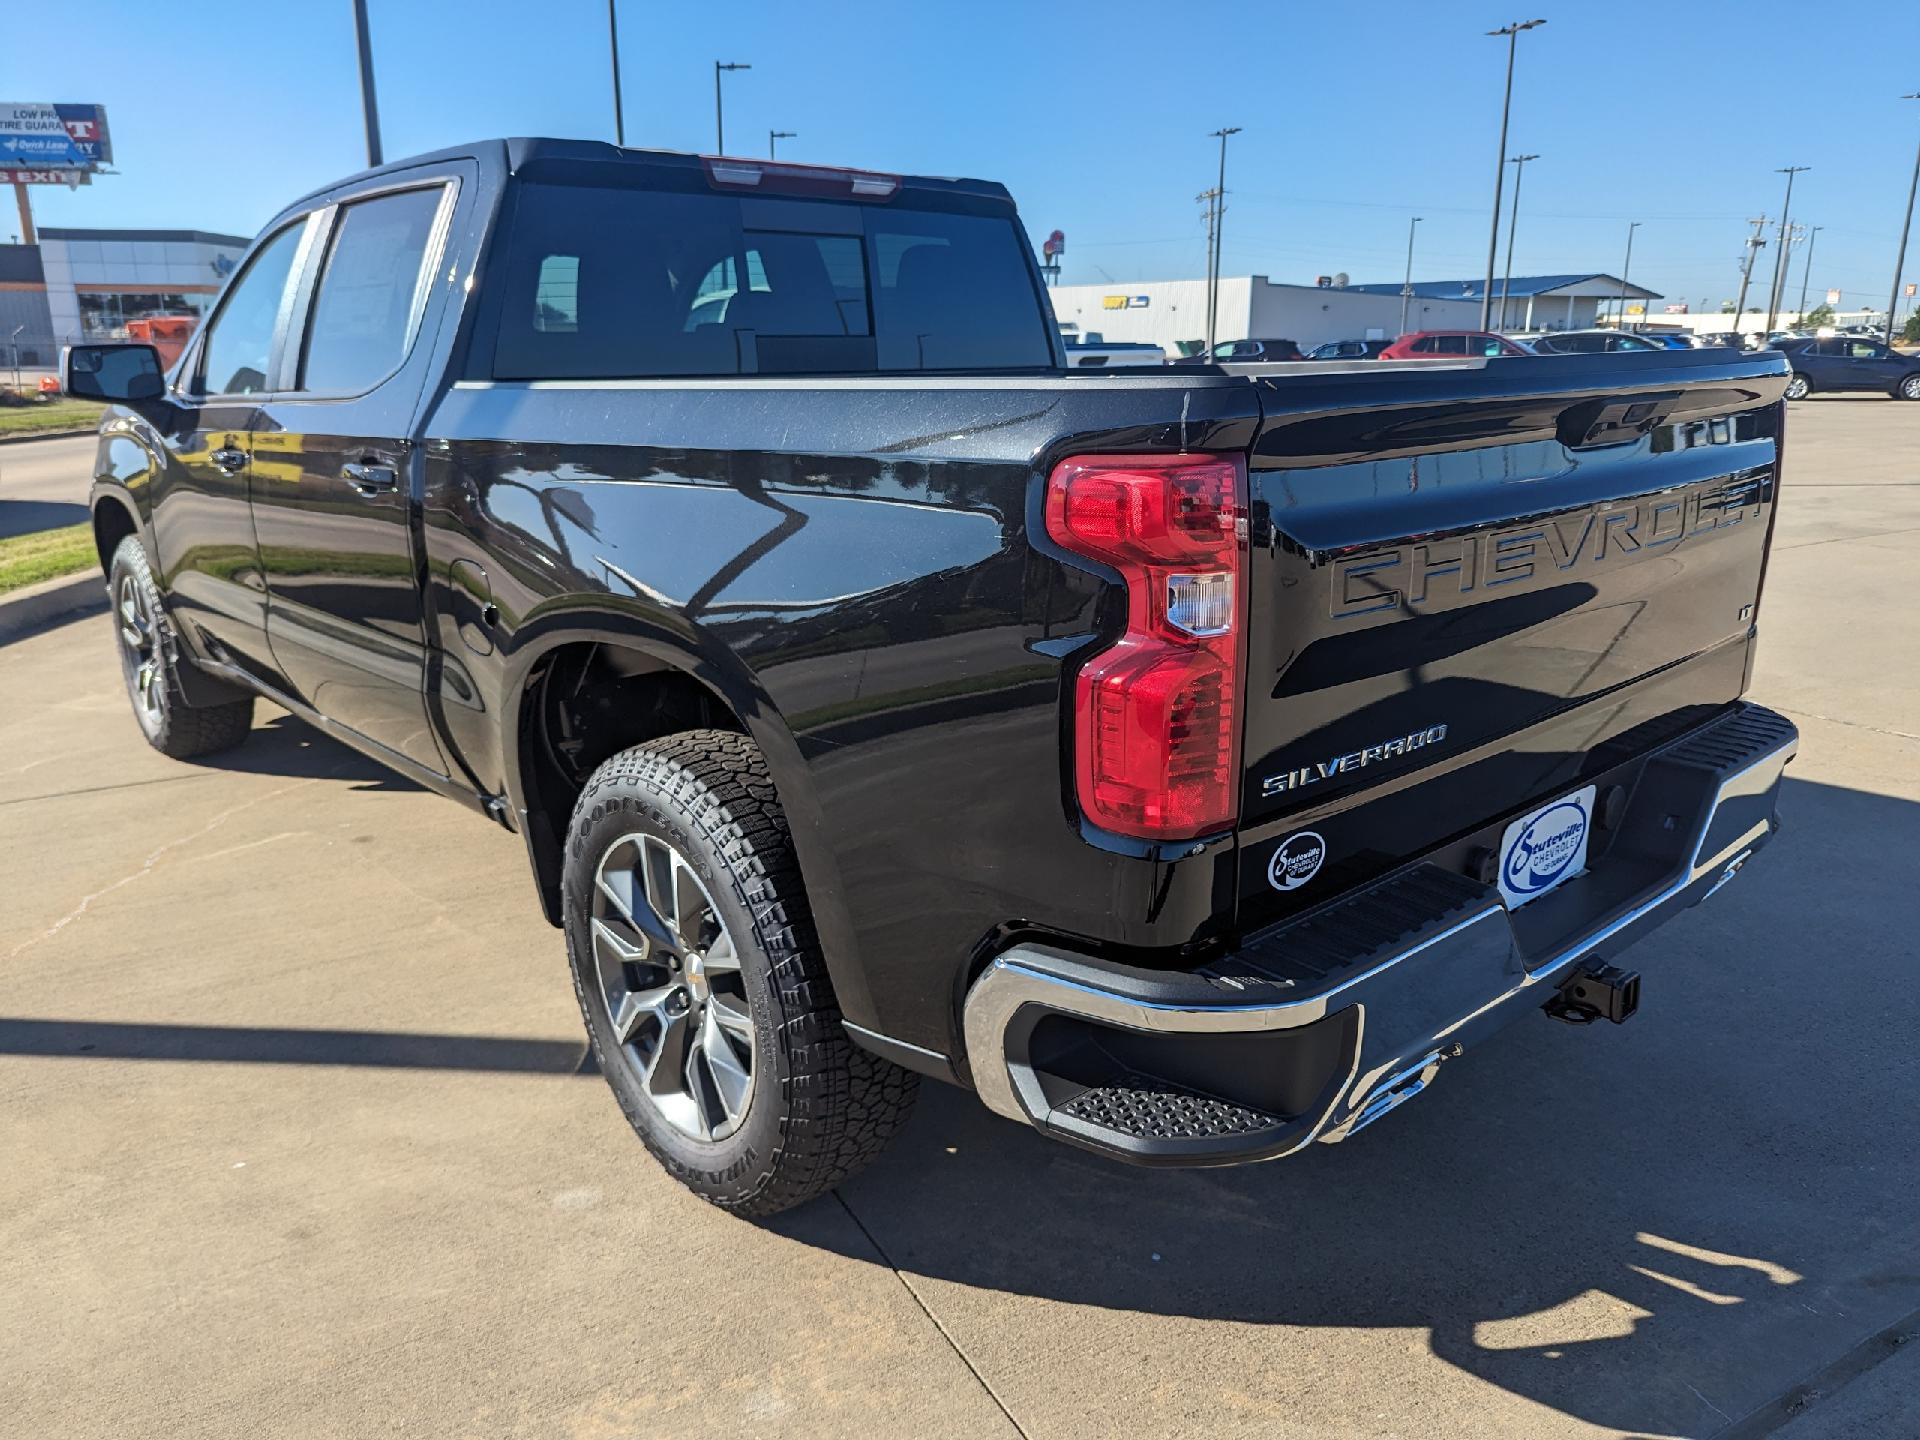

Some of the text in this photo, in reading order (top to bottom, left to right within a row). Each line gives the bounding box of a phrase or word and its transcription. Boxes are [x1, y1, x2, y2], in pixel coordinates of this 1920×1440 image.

[13, 110, 37, 119] LOW
[18, 140, 69, 150] Quick Lane
[1330, 476, 1771, 619] CHEVROLET
[1262, 723, 1448, 797] SILVERADO
[1533, 835, 1579, 867] CHEVROLET
